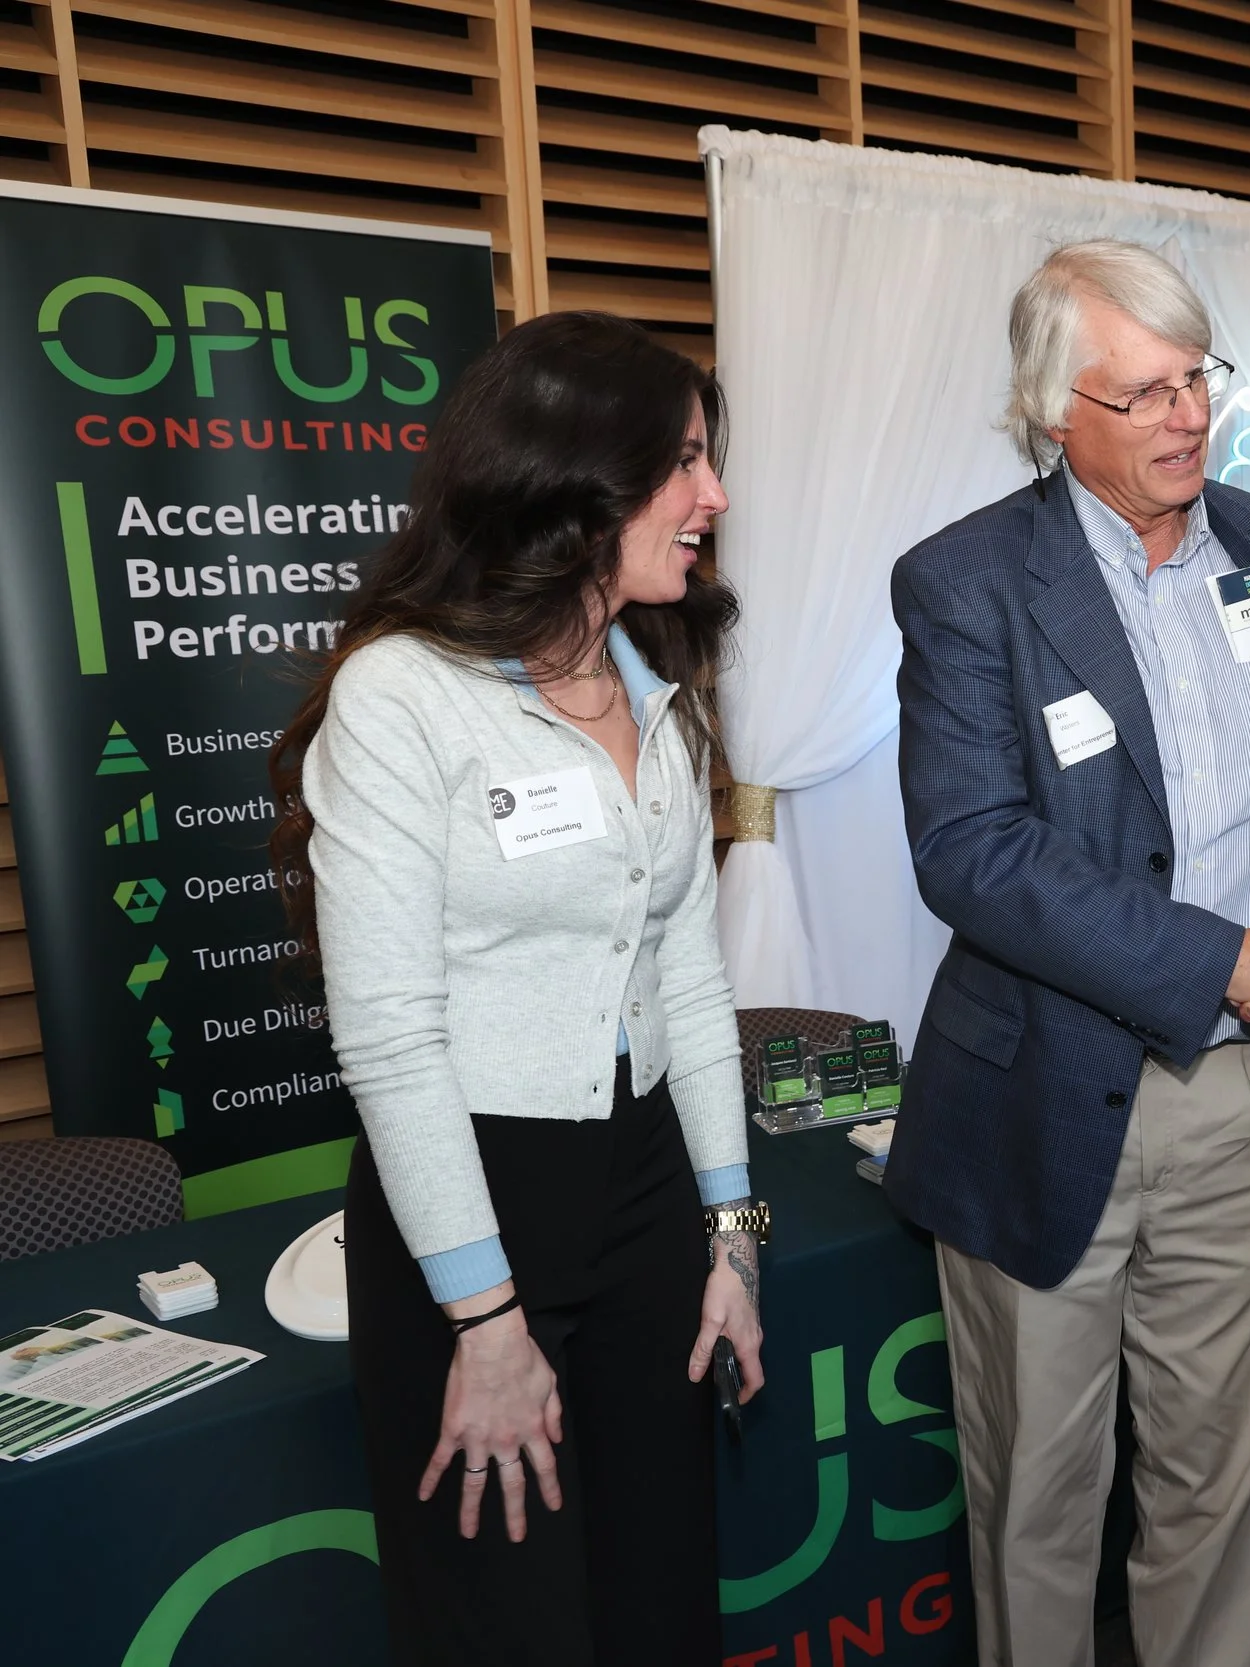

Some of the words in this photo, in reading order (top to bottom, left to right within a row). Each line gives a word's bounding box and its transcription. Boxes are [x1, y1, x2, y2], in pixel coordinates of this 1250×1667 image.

[38, 276, 440, 405] OPUS
[75, 415, 429, 452] CONSULTING
[125, 555, 360, 598] Business
[1055, 711, 1068, 720] Eric
[166, 728, 285, 757] Business
[528, 785, 557, 798] Danielle
[175, 797, 275, 829] Growth
[531, 801, 558, 812] Couture
[516, 832, 538, 843] Opus
[541, 821, 582, 837] Consulting
[203, 1016, 256, 1042] Due
[856, 1028, 883, 1039] OPUS
[768, 1040, 796, 1052] OPUS
[863, 1048, 890, 1060] OPUS
[826, 1055, 854, 1067] OPUS
[212, 1071, 340, 1111] Complian
